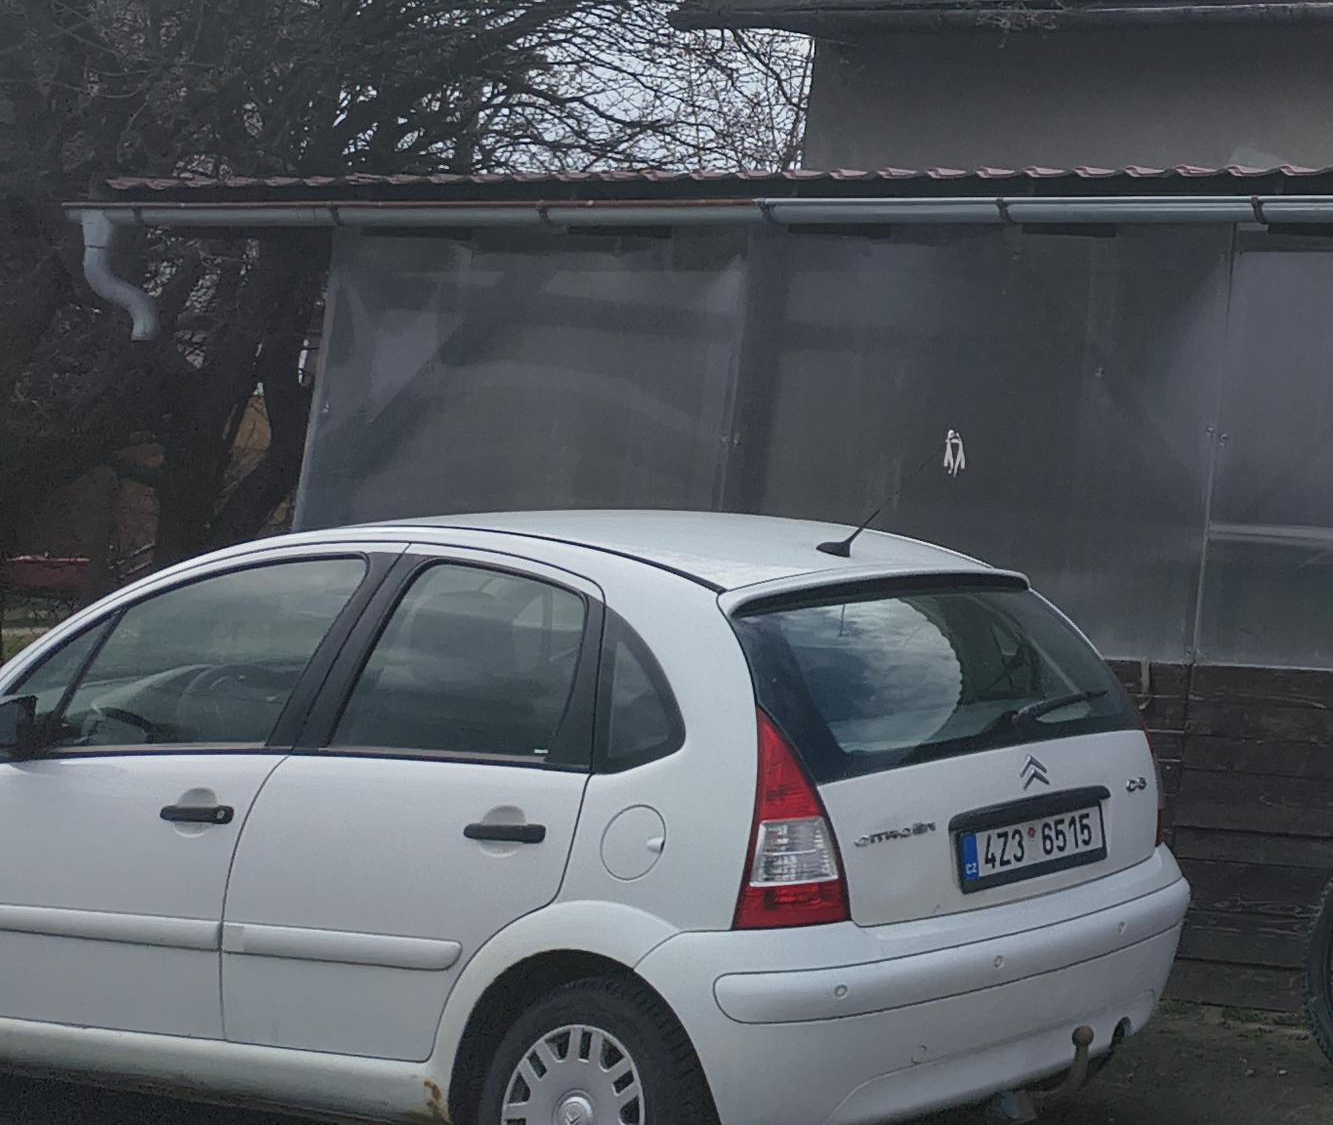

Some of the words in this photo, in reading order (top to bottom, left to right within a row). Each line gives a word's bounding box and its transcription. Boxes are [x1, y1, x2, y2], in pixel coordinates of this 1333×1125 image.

[1126, 777, 1147, 792] C3
[984, 829, 1025, 869] 4Z3
[1041, 813, 1092, 855] 6515
[965, 862, 978, 874] CZ
